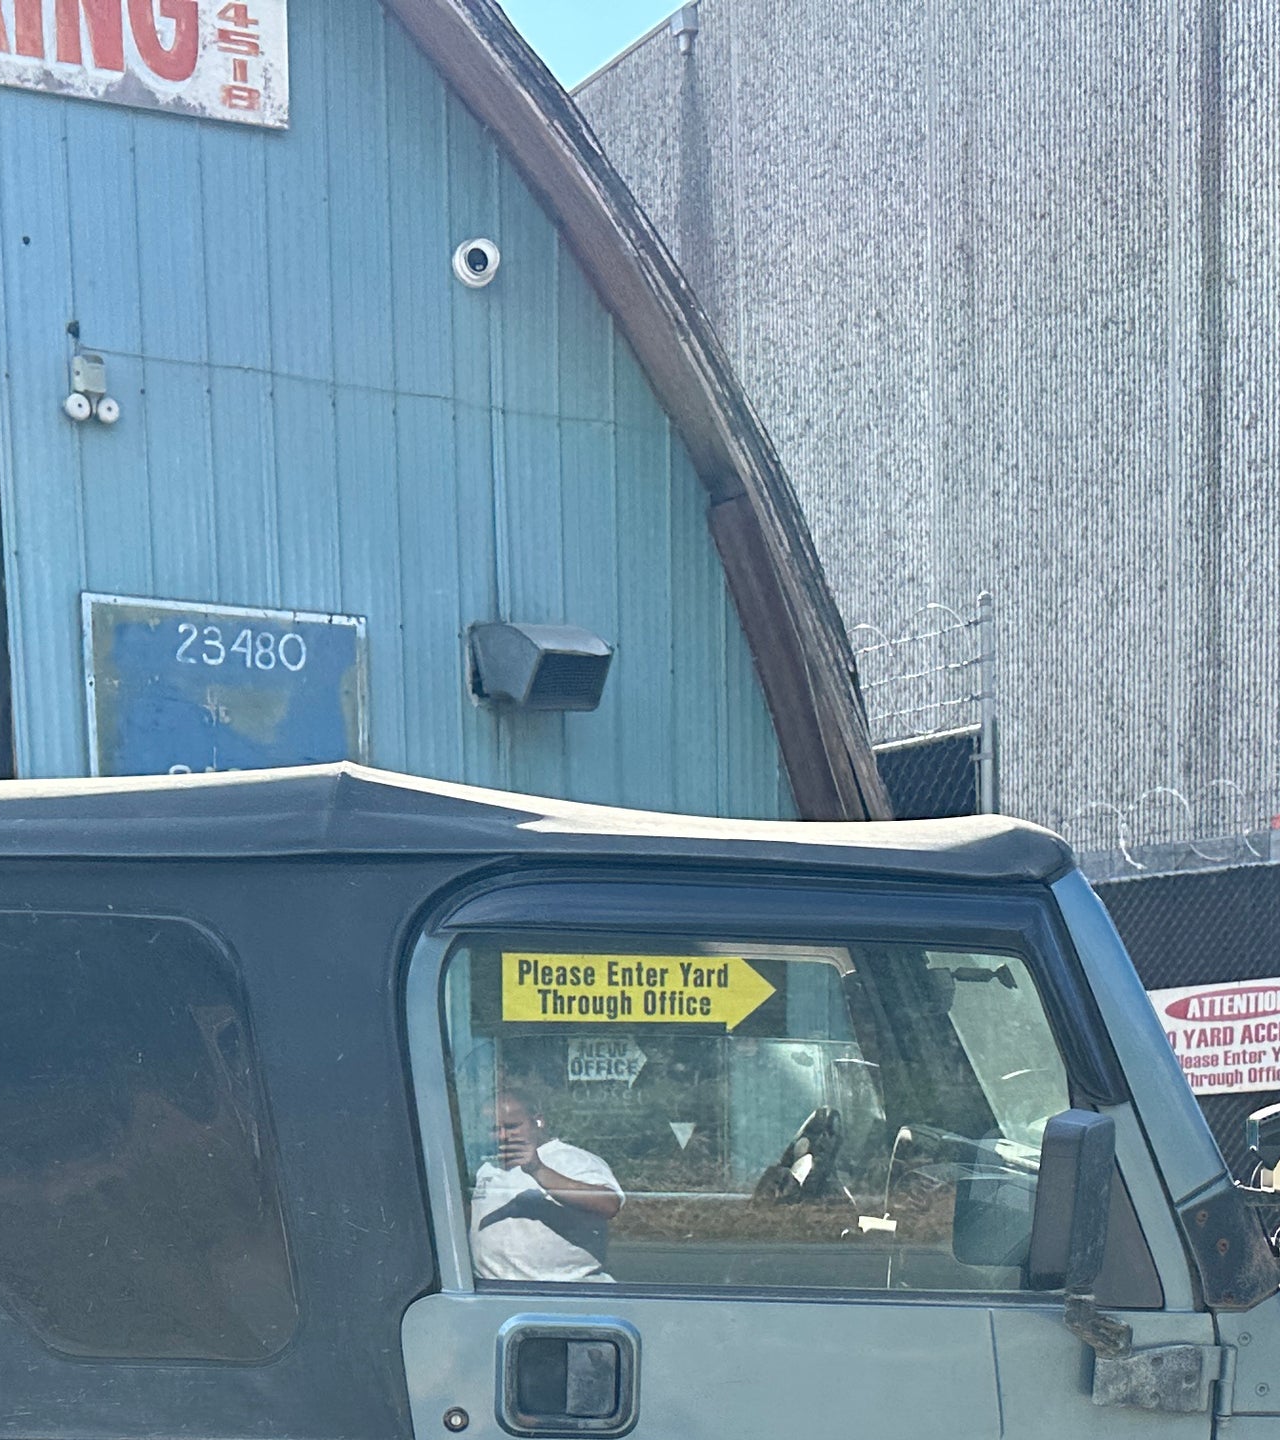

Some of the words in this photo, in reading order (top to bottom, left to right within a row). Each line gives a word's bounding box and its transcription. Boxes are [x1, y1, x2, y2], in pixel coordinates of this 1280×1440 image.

[176, 623, 307, 672] 23480
[517, 958, 596, 987] Please
[606, 960, 670, 988] Enter
[678, 961, 730, 988] Yard
[536, 988, 633, 1020] Through
[642, 989, 712, 1017] Office
[1183, 1025, 1235, 1050] YARD
[570, 1058, 638, 1076] OFFICE
[1177, 1054, 1219, 1070] lease
[1223, 1049, 1267, 1067] Enter
